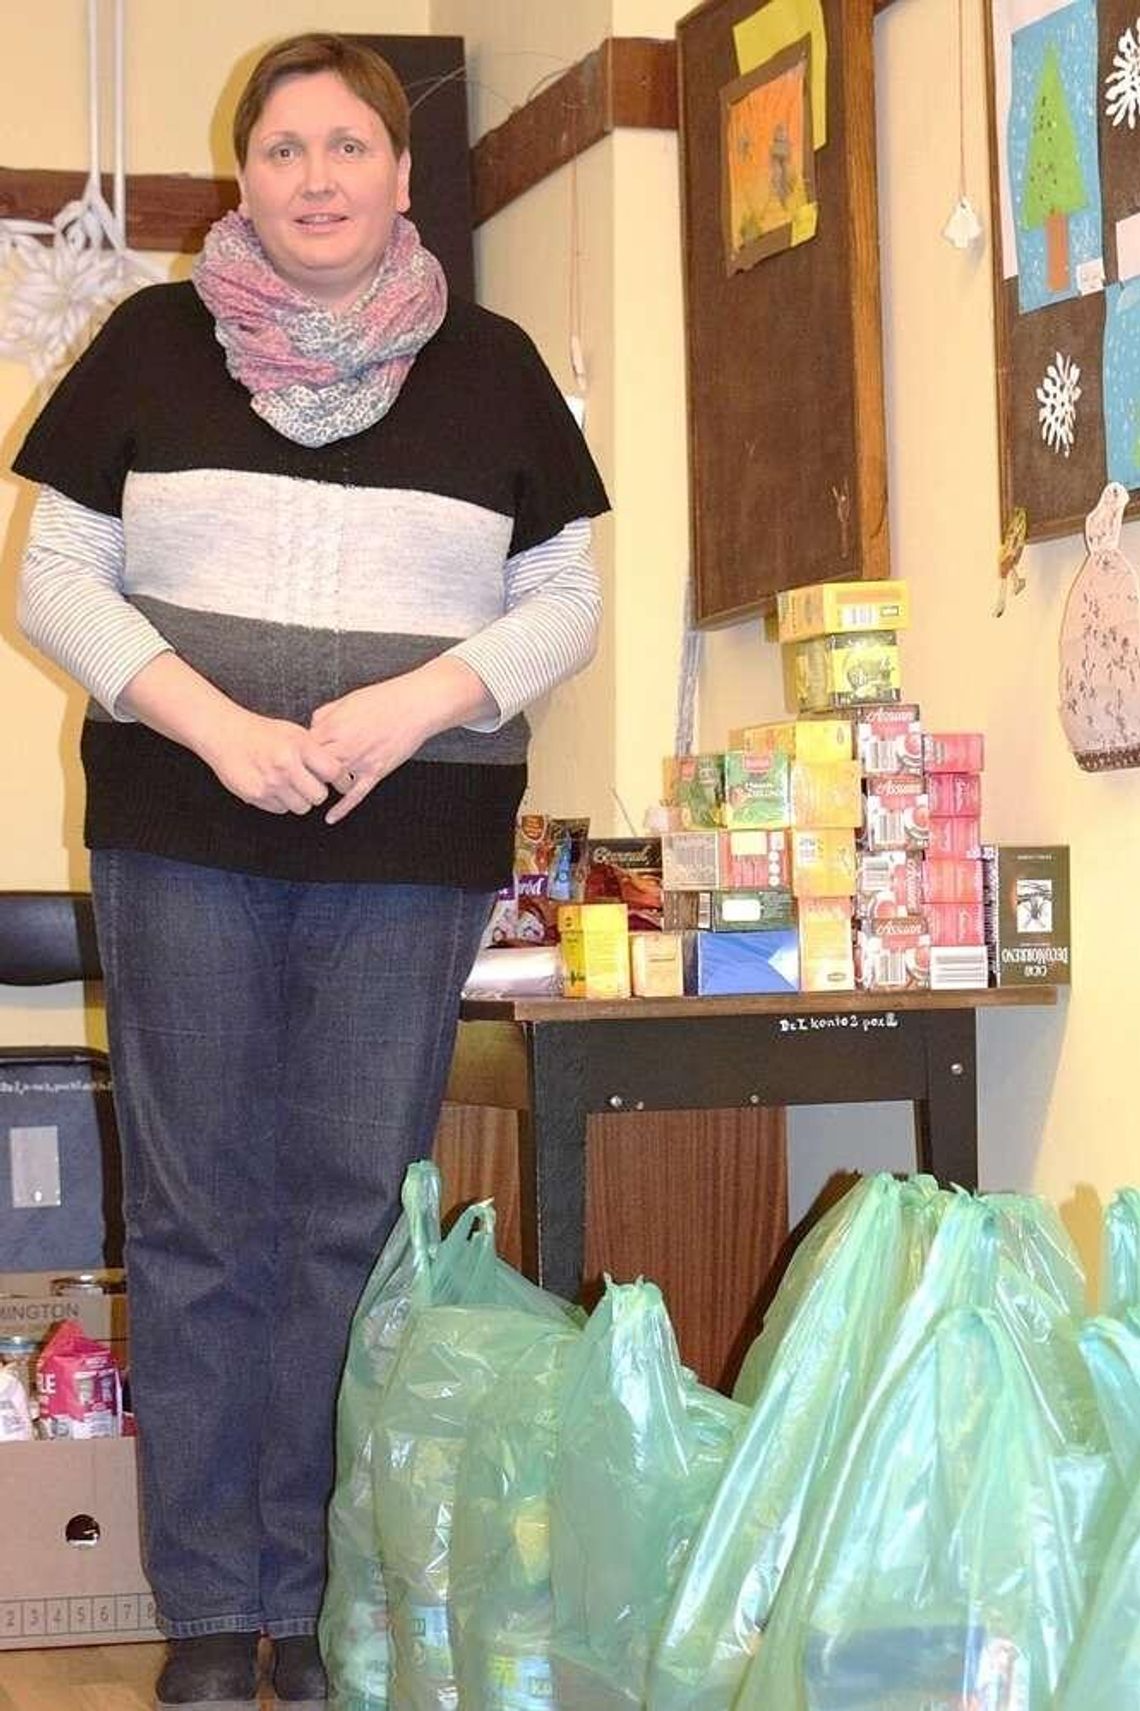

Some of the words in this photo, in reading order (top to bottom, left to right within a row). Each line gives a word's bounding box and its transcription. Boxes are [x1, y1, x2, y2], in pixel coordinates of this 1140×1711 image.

[76, 1606, 86, 1623] 5
[100, 1605, 109, 1623] 6
[123, 1603, 132, 1620] 7
